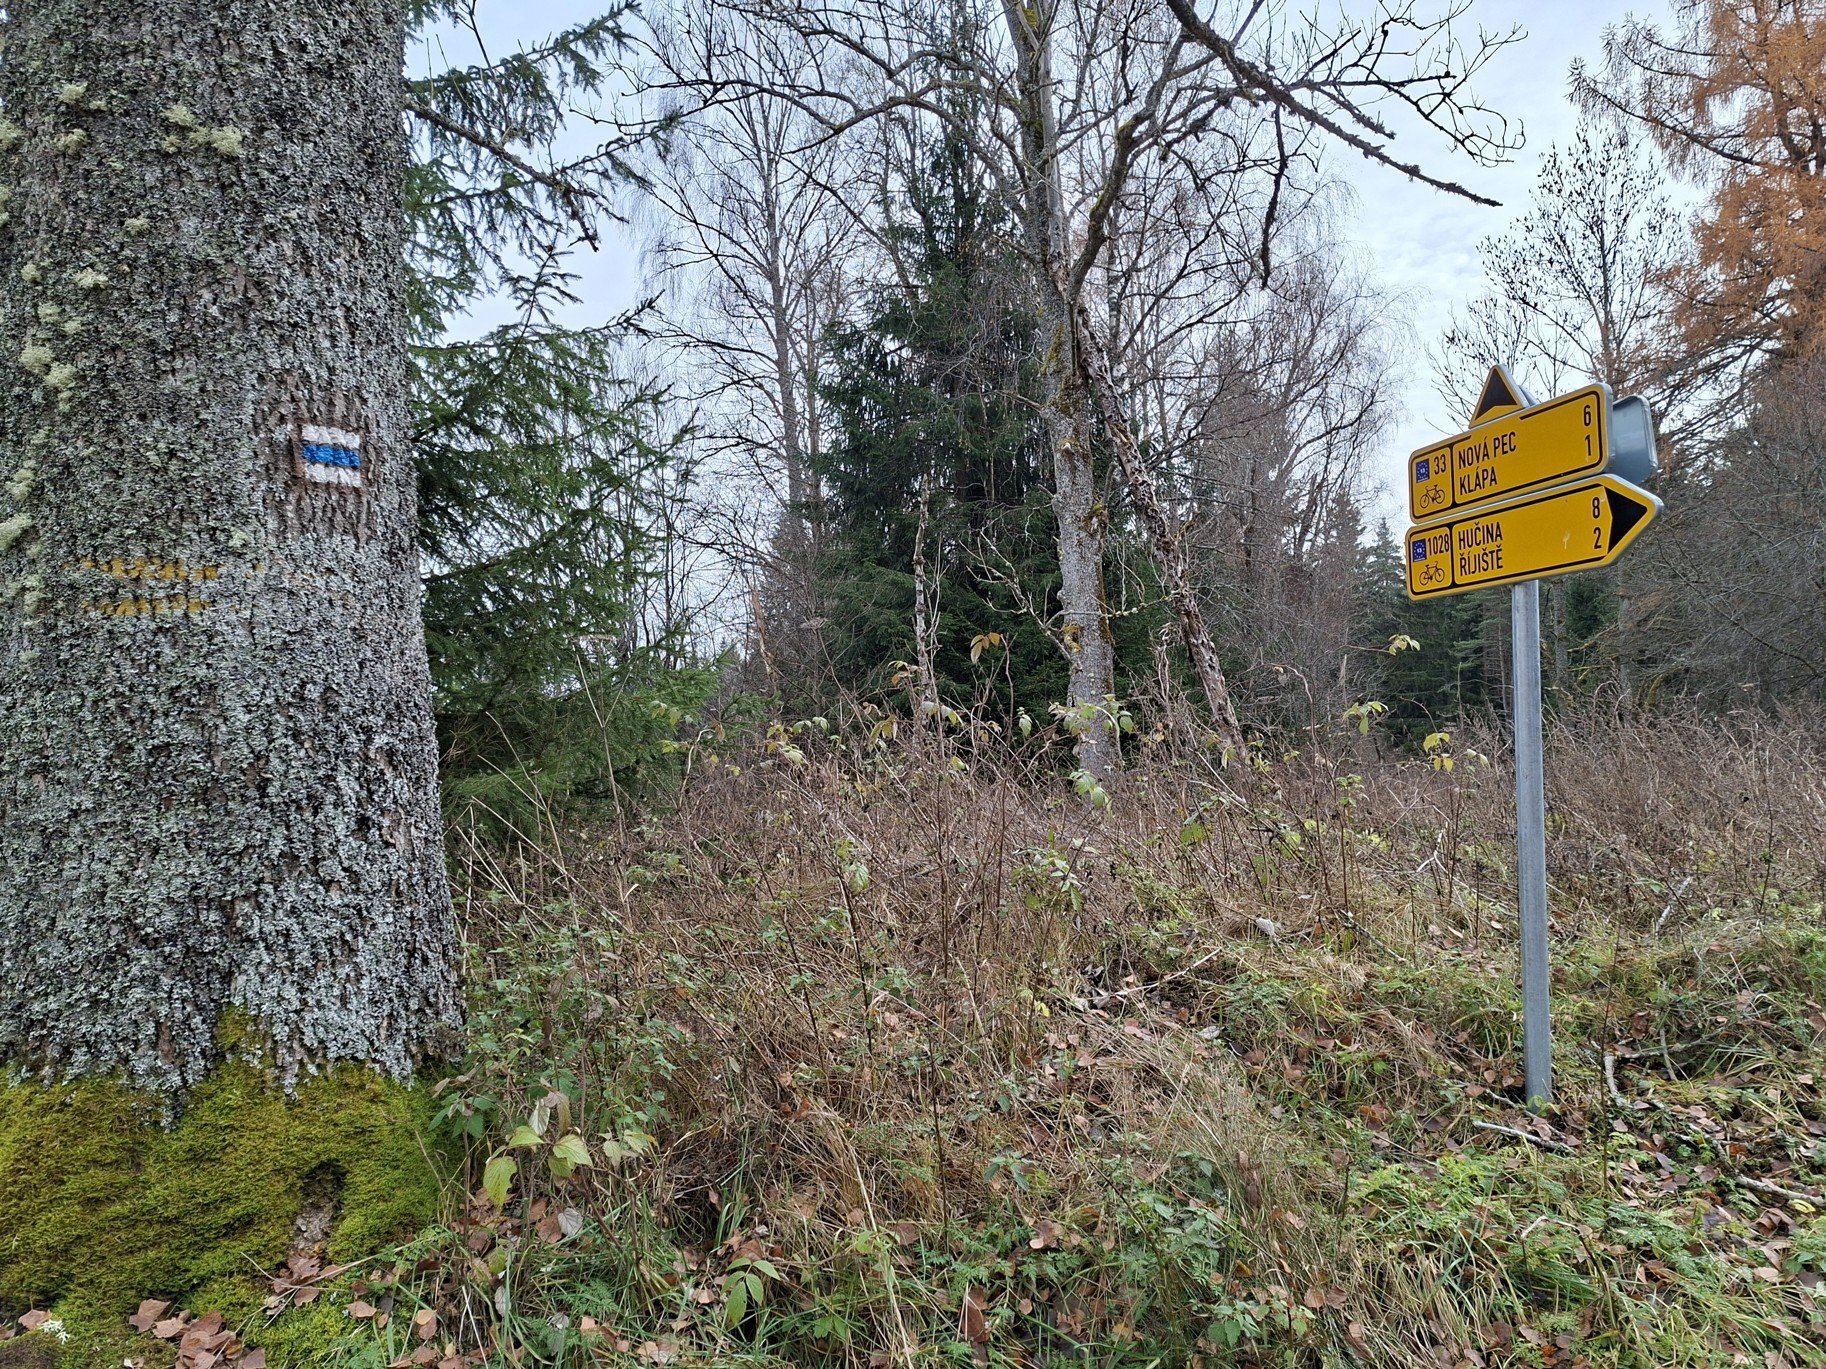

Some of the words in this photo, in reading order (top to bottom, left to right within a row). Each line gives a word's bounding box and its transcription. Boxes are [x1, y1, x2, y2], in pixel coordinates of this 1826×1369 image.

[1458, 436, 1490, 470] NOVÁ
[1493, 431, 1516, 458] PEC
[1583, 404, 1592, 427] 6
[1434, 454, 1447, 475] 33
[1459, 466, 1498, 496] KLÁPA
[1584, 434, 1592, 456] 1
[1427, 533, 1450, 556] 1028
[1458, 521, 1503, 550] HUČINA
[1592, 496, 1600, 519] 8
[1459, 544, 1504, 577] ŘÍJIŠTĚ
[1593, 526, 1602, 549] 2
